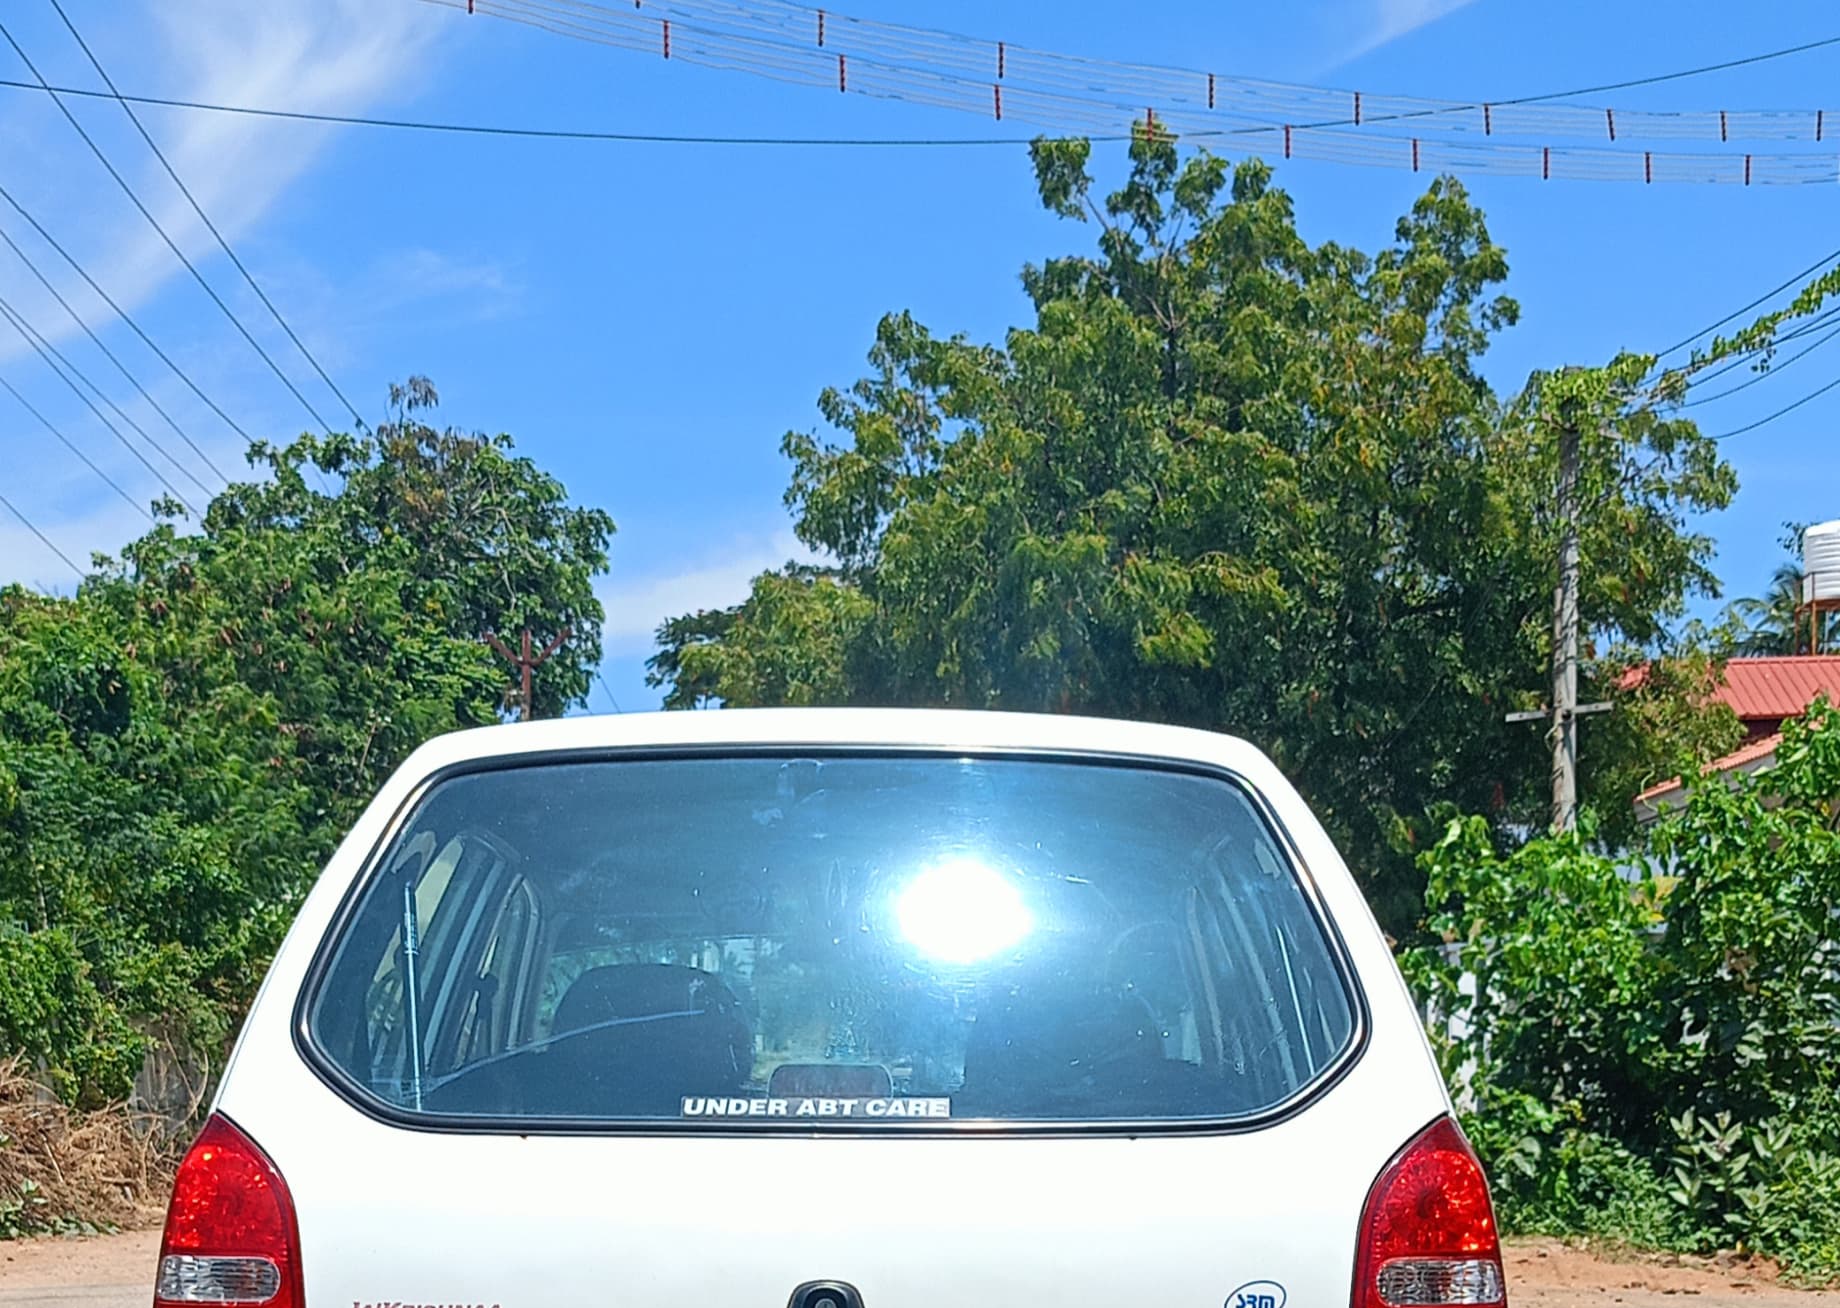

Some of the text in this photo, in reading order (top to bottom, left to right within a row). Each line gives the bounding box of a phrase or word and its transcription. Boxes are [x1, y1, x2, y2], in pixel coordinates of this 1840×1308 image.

[683, 1097, 949, 1117] UNDER ABT CARE
